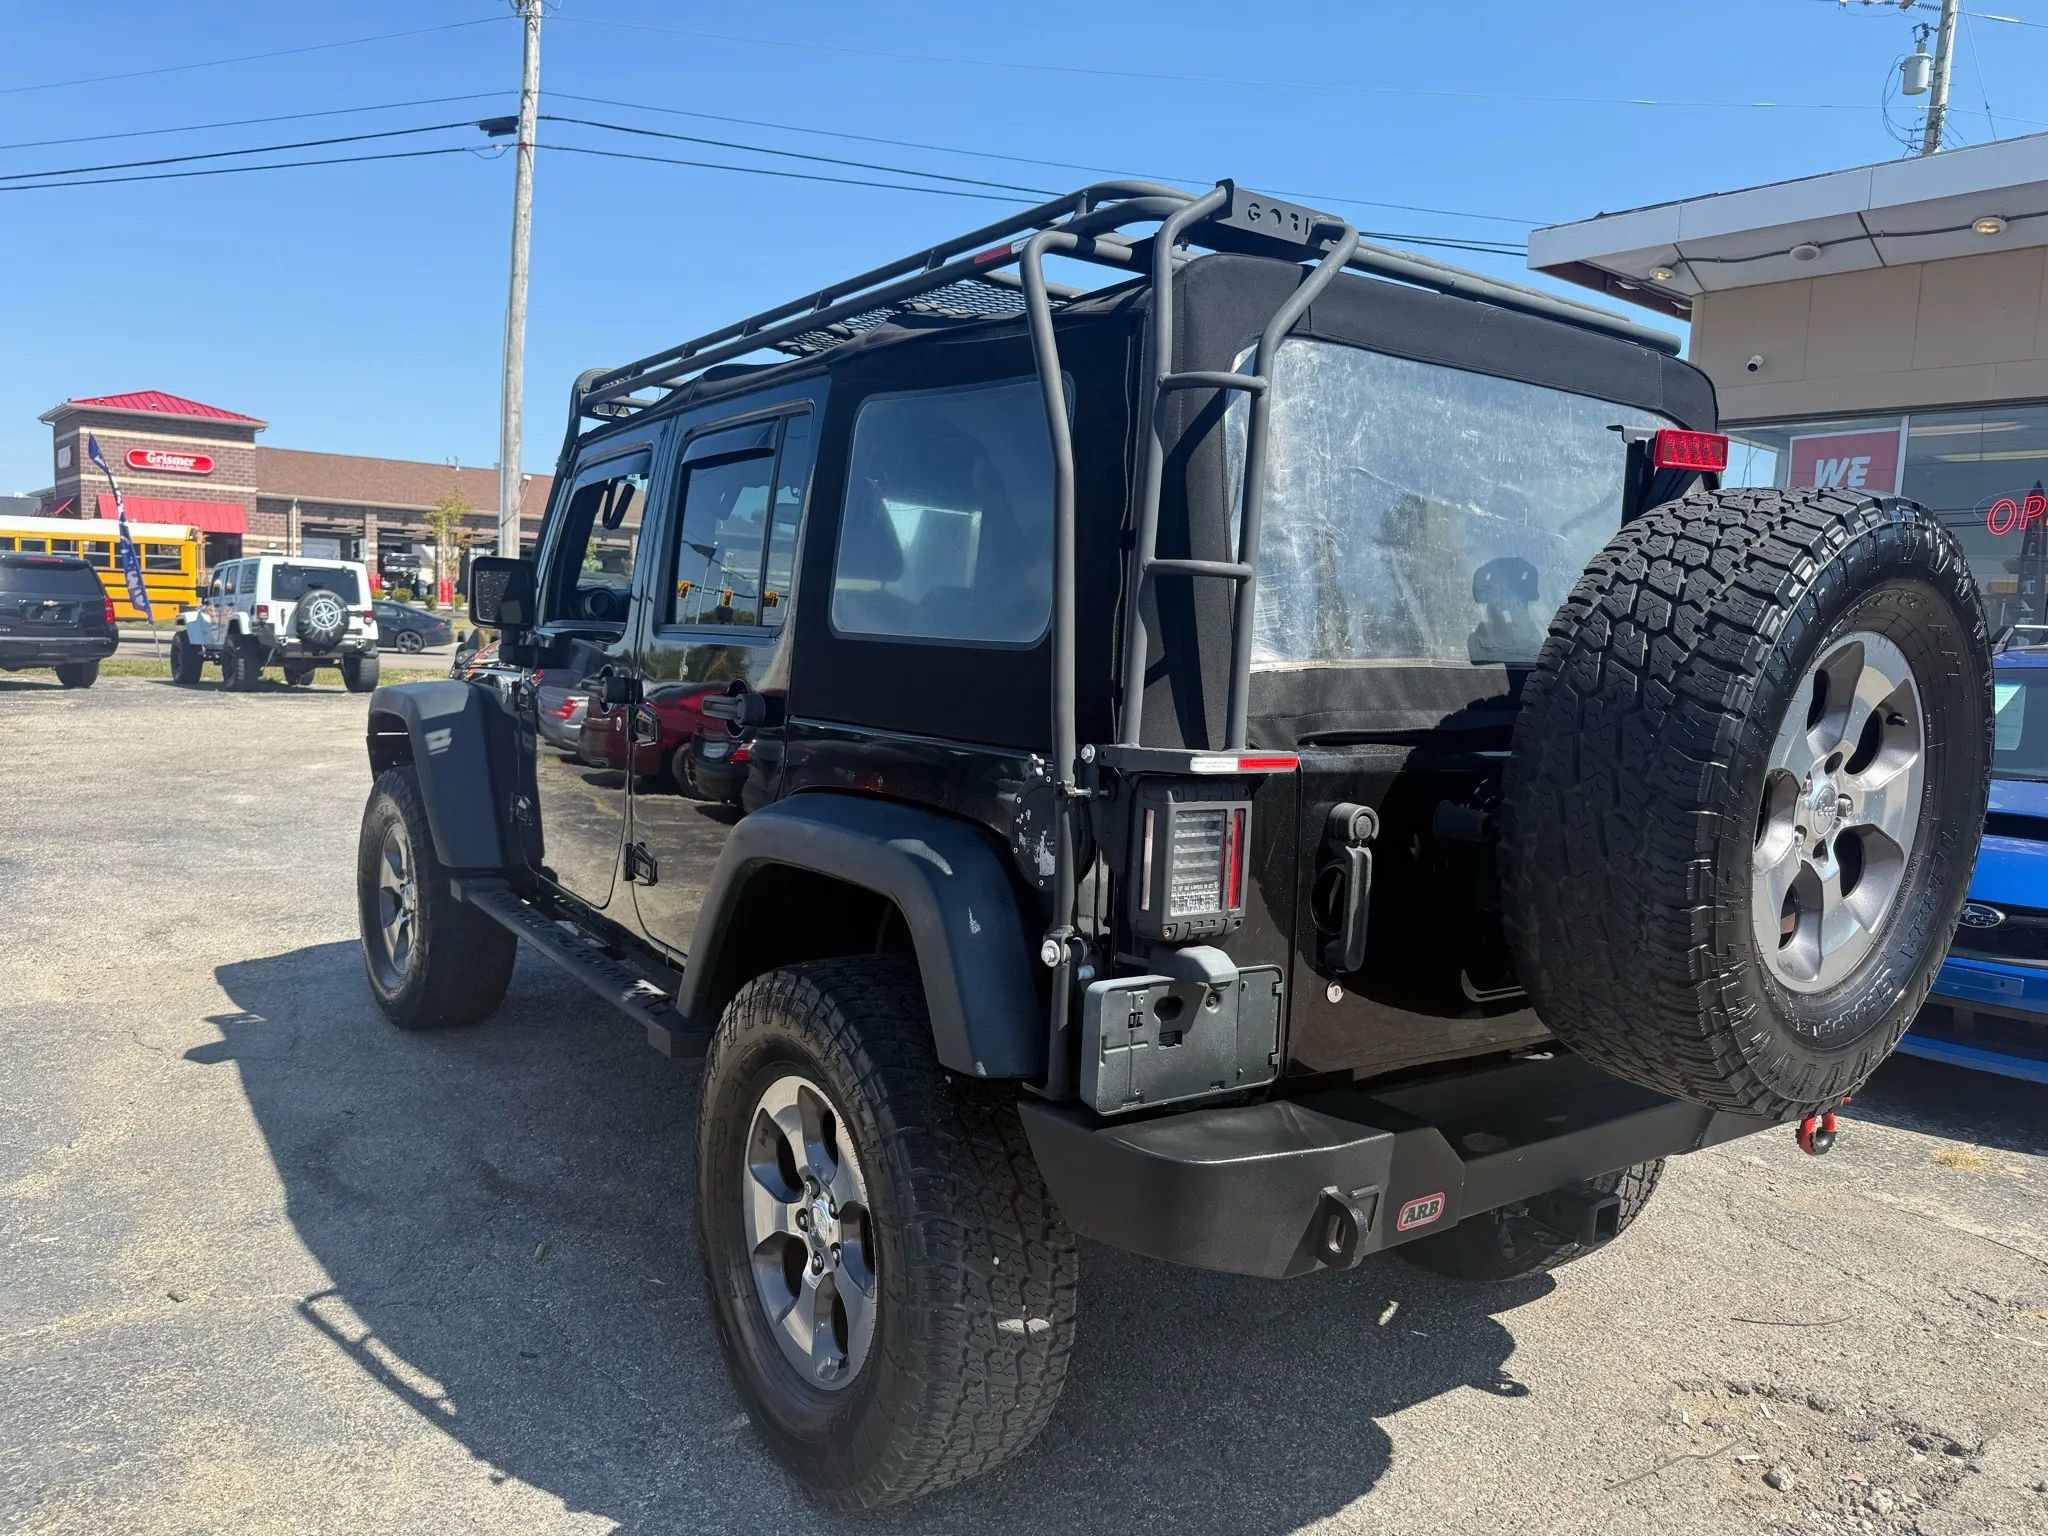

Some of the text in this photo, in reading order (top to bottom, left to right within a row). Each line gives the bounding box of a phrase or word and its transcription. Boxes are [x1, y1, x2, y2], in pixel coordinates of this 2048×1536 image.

[146, 452, 197, 467] Grismer
[1814, 456, 1871, 488] WE
[1987, 495, 2048, 535] OP
[1403, 1199, 1440, 1225] ARB
